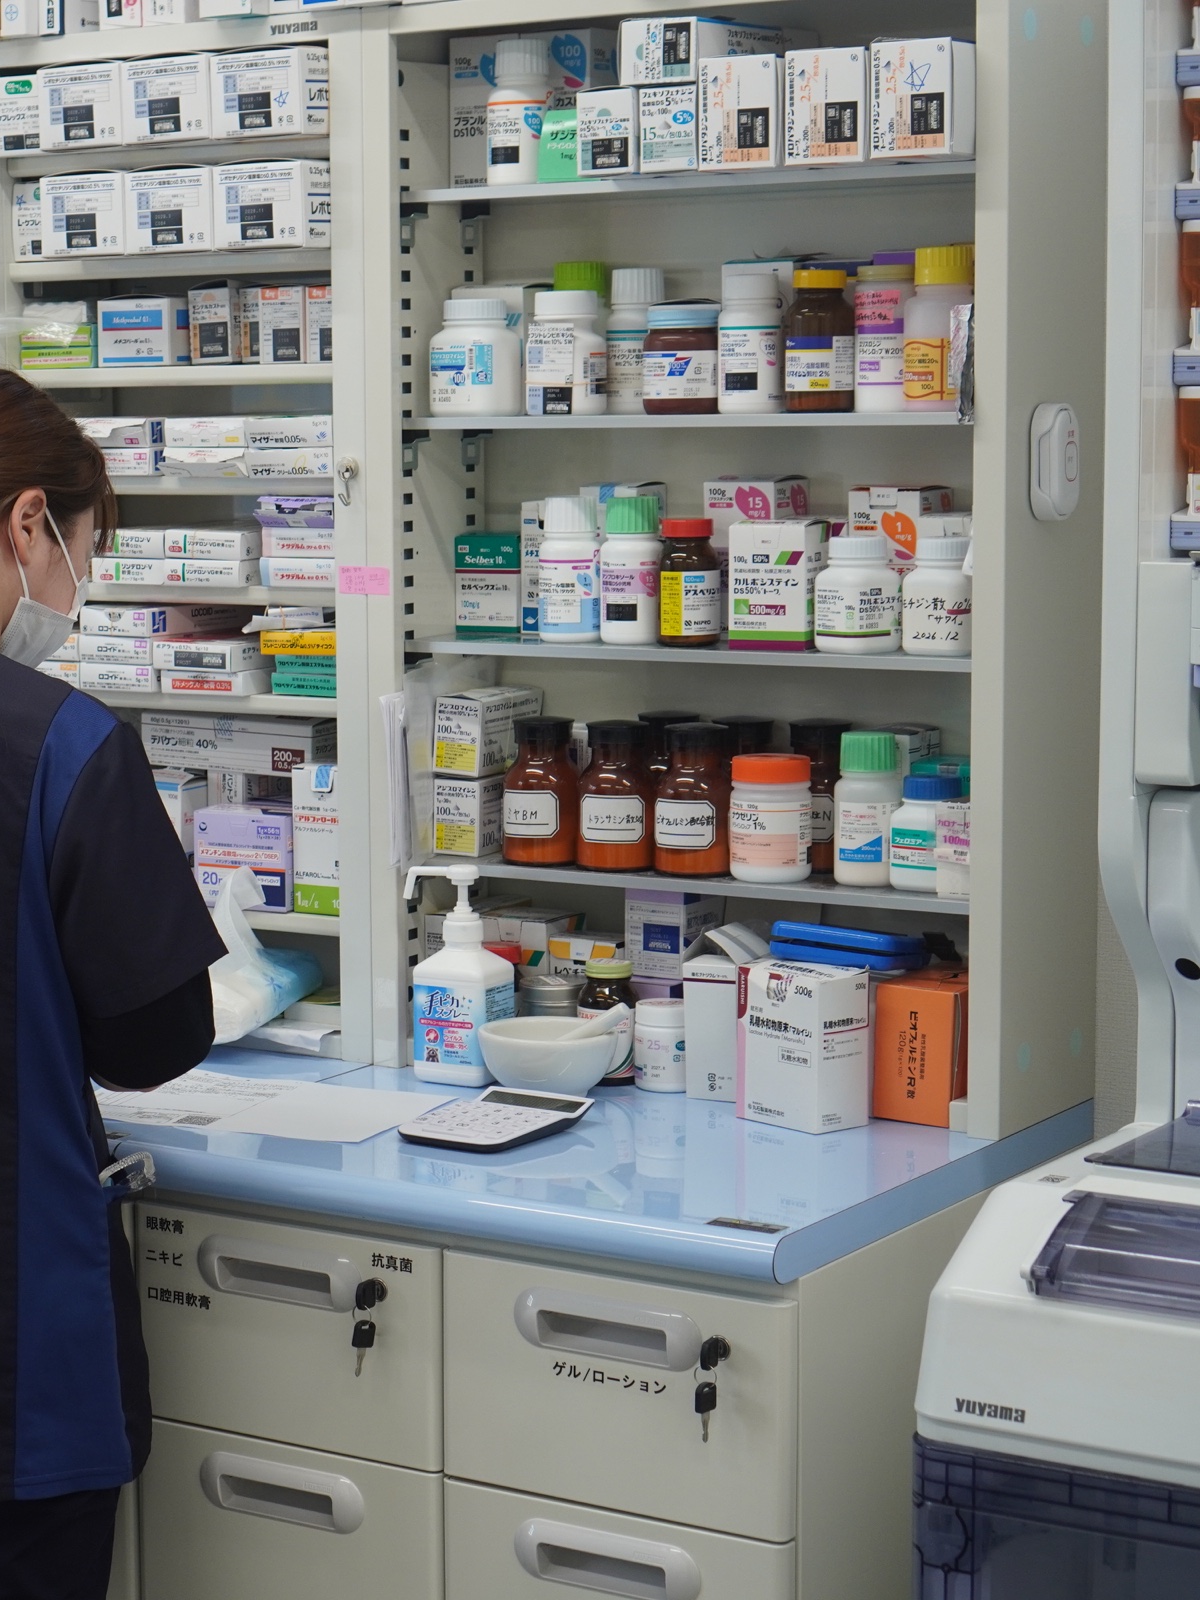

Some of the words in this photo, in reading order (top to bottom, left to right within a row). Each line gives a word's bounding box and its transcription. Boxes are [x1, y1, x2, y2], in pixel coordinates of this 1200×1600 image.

[270, 20, 318, 36] yuyama
[559, 45, 581, 57] 100
[454, 57, 471, 65] 100g
[564, 59, 581, 67] mg/g
[642, 89, 694, 99] フェキソフェナジン
[453, 116, 487, 126] プランル
[676, 113, 691, 123] 5%
[453, 126, 484, 137] DS10%
[454, 373, 465, 383] 100
[709, 488, 726, 497] 100g
[748, 497, 762, 508] 15
[854, 512, 871, 520] 100g
[896, 522, 902, 532] 1
[464, 555, 494, 565] Selbex
[733, 556, 748, 564] 100g
[733, 578, 799, 587] カルボシステイン
[191, 607, 213, 617] LOCOID
[750, 605, 785, 615] 500mg/g
[195, 739, 218, 750] 40%
[508, 808, 537, 820] ミヤBM
[753, 822, 766, 831] 1%
[855, 982, 867, 990] 500g
[794, 985, 813, 999] 500g
[749, 1014, 812, 1038] 乳糖水和物原末「マルイシ」
[146, 1216, 184, 1235] 眼軟膏
[146, 1249, 183, 1267] ニキビ
[371, 1252, 413, 1274] 抗真菌
[147, 1286, 211, 1310] 口腔用軟膏
[552, 1361, 667, 1395] ゲル/ローション
[954, 1397, 1026, 1423] yuyama
